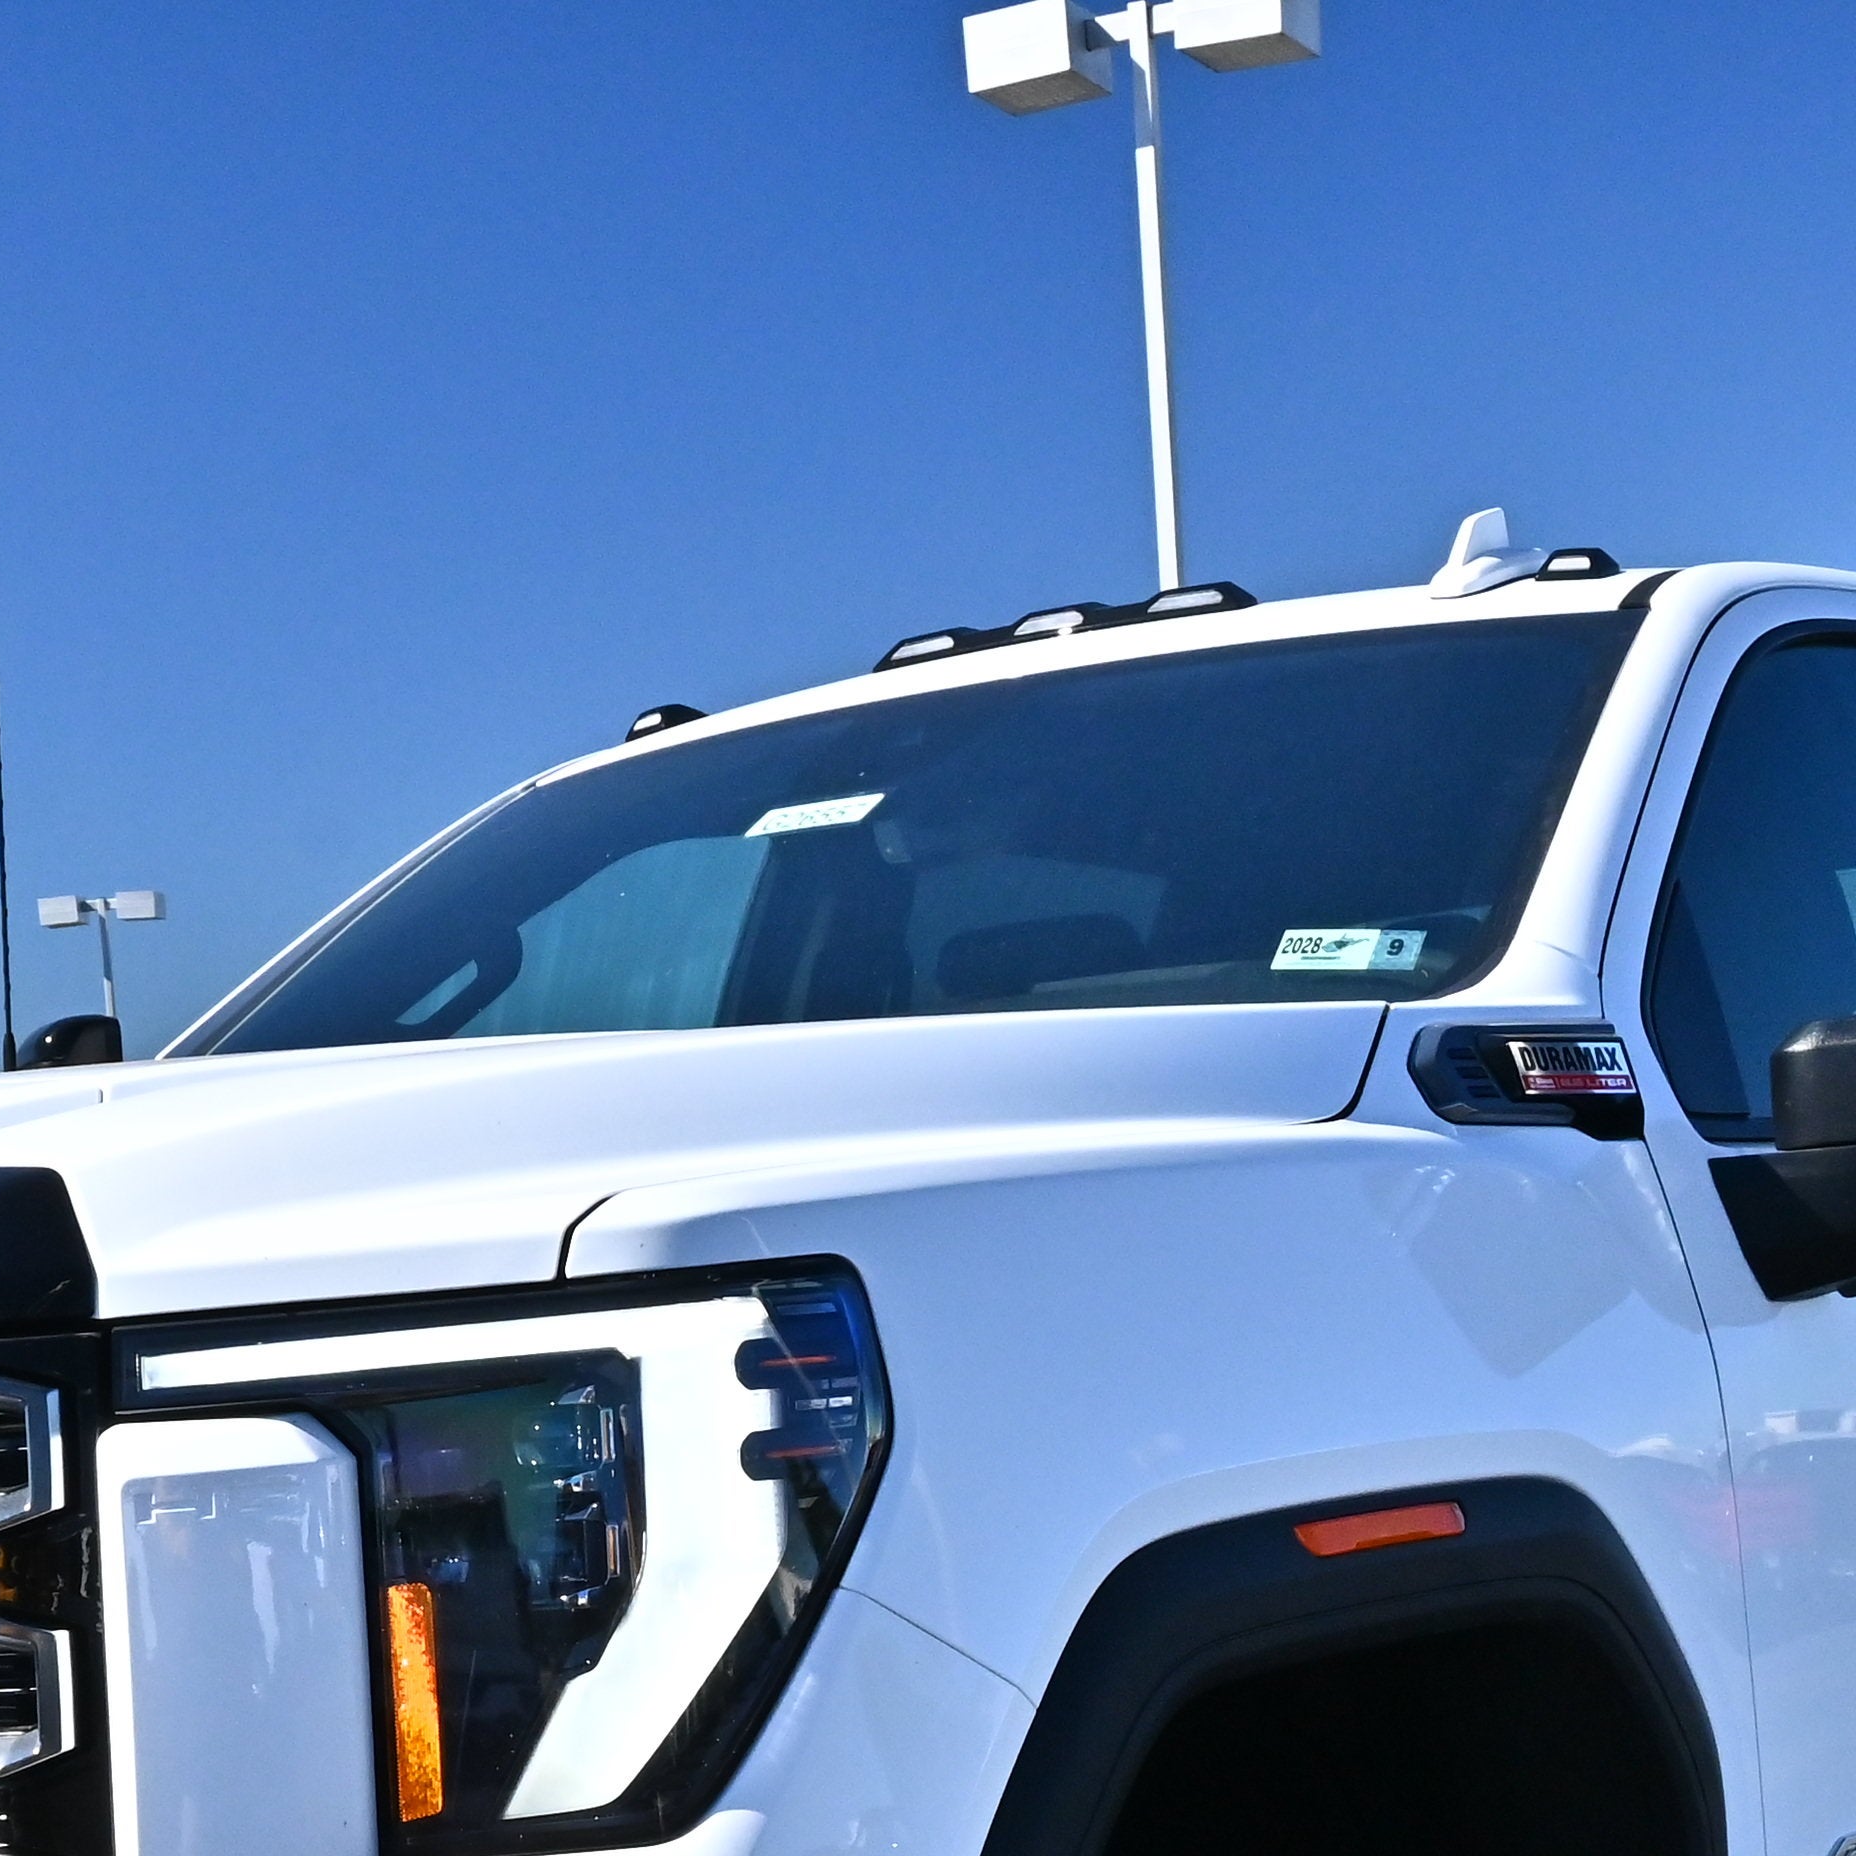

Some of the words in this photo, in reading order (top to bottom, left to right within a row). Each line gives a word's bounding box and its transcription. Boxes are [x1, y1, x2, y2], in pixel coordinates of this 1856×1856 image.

[1281, 936, 1324, 954] 2028
[1386, 938, 1405, 956] 9
[1517, 1045, 1623, 1072] DURAMAX
[1586, 1078, 1627, 1087] LITER
